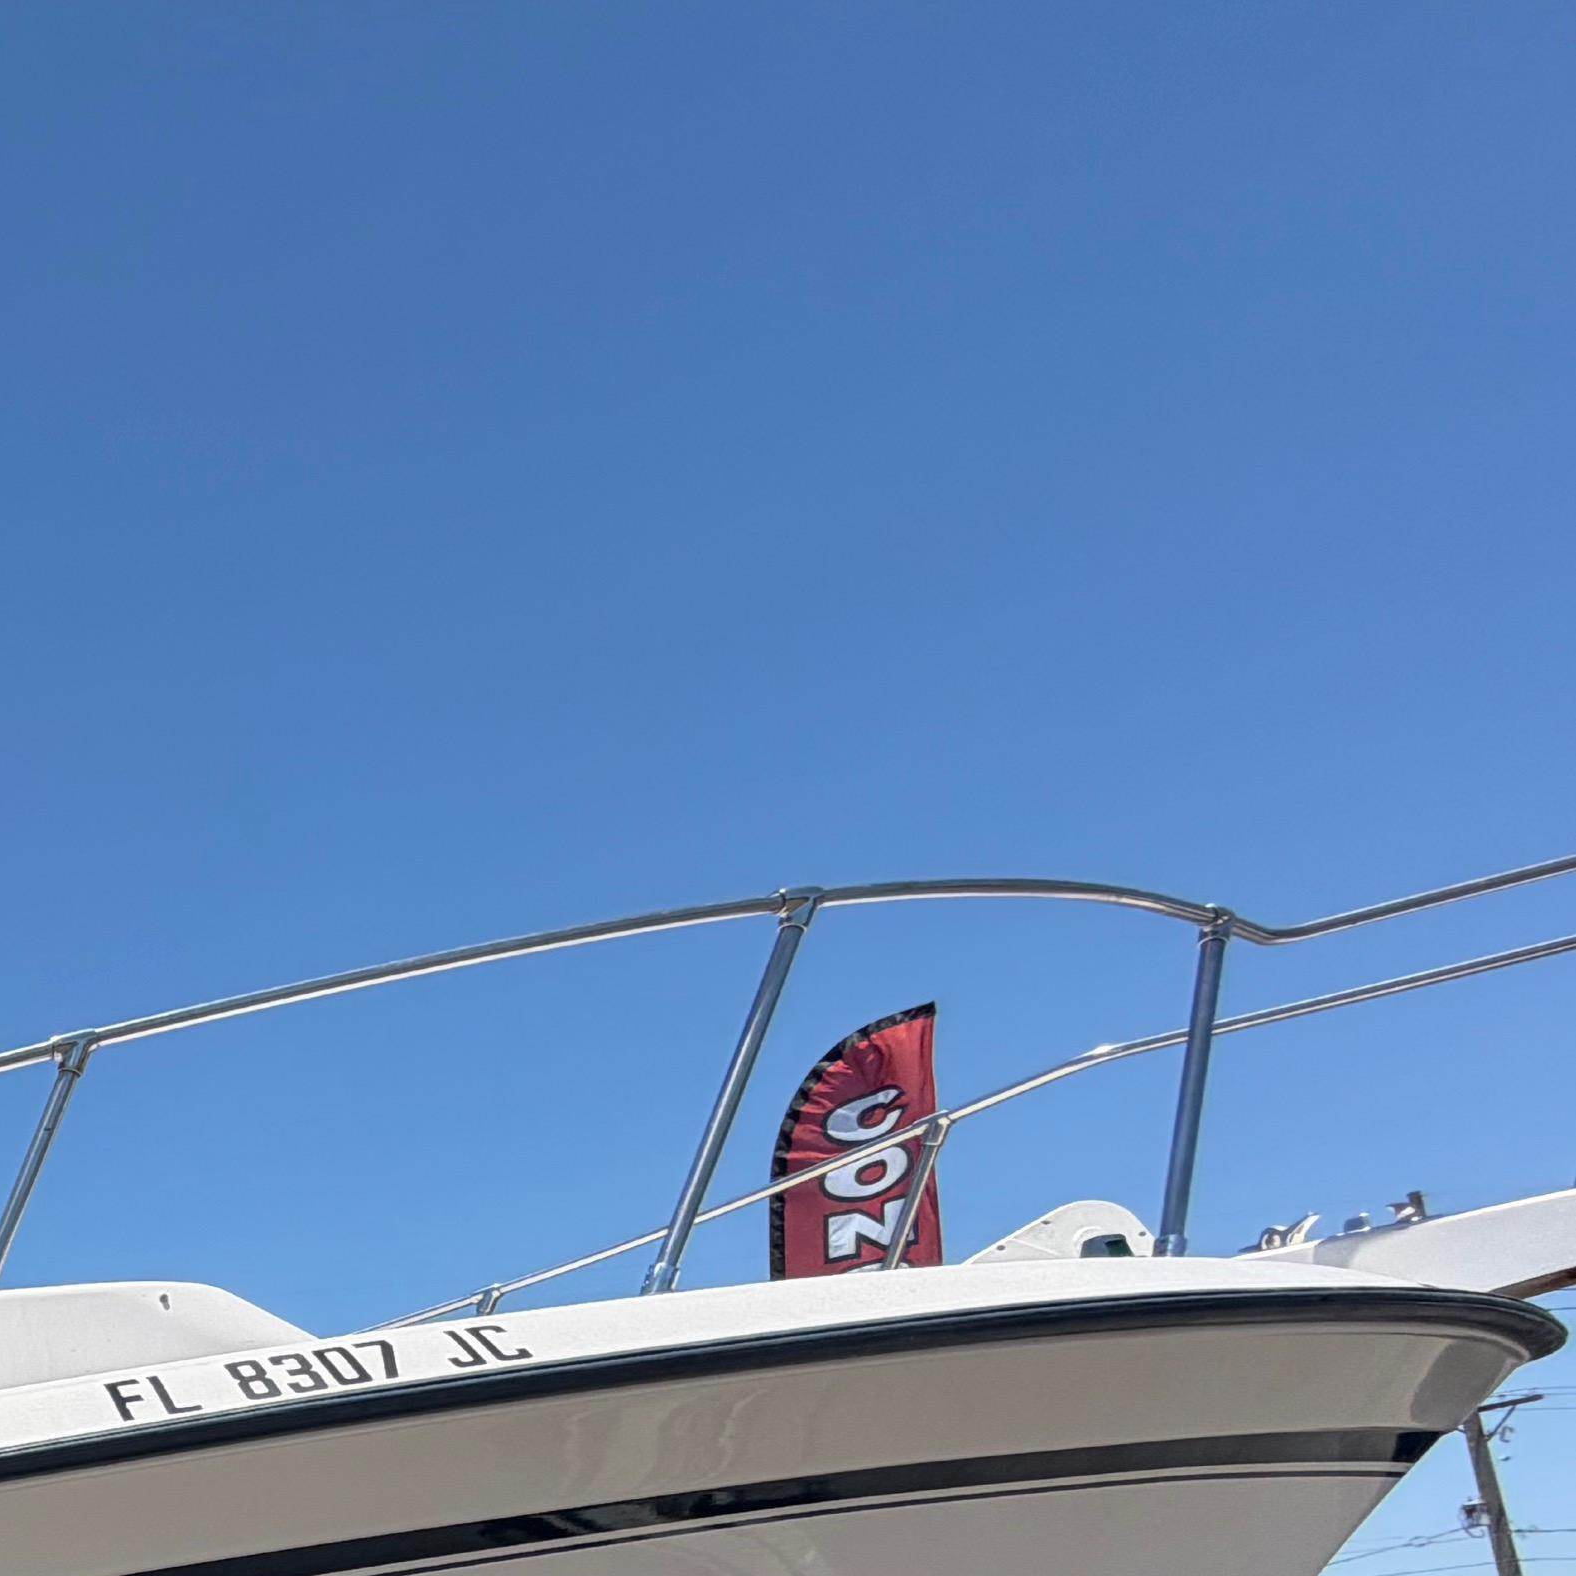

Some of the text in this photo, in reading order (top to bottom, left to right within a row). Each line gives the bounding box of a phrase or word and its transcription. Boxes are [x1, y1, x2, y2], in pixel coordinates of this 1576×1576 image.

[824, 1085, 917, 1273] CON
[104, 1325, 533, 1421] FL 8307 JC
